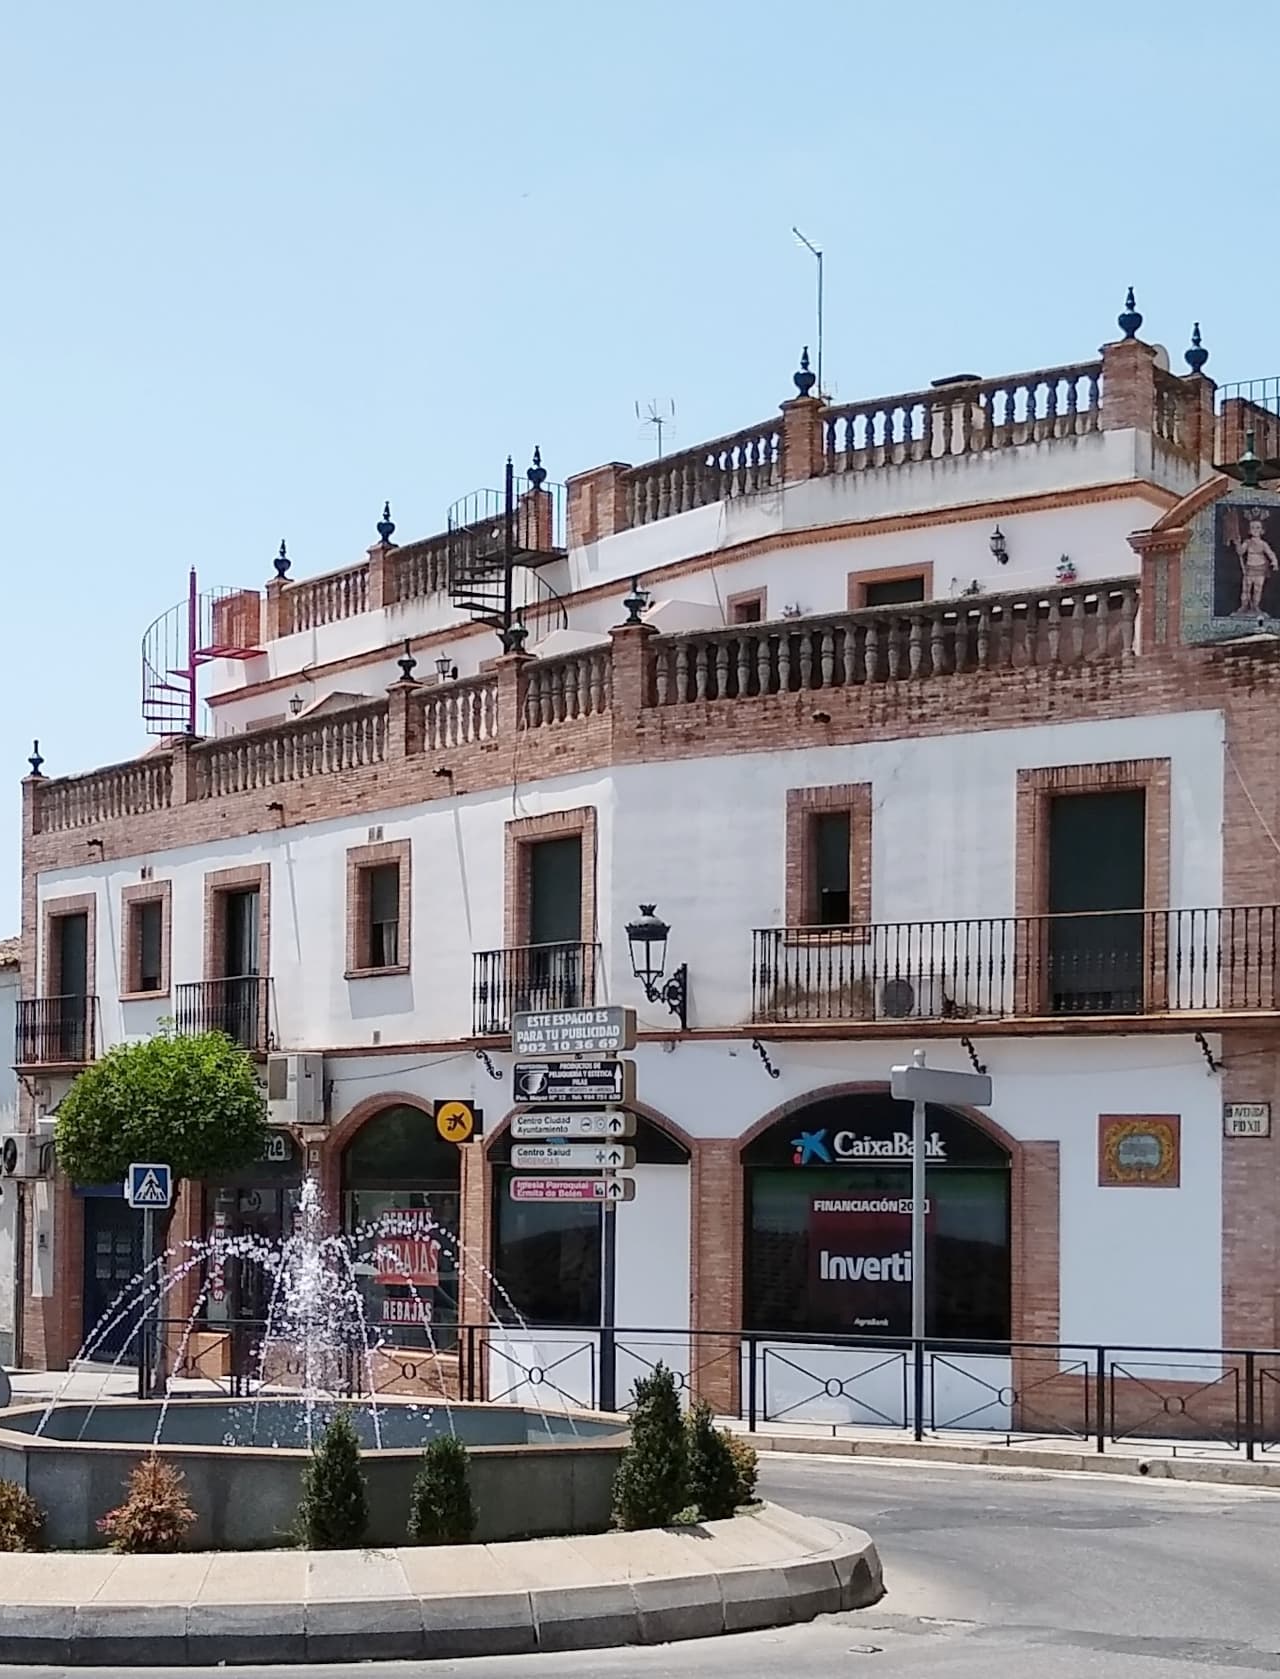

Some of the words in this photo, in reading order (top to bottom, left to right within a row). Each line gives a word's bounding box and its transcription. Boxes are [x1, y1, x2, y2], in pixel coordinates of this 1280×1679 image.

[527, 1015, 551, 1028] ESTE
[552, 1012, 593, 1026] ESPACIO
[596, 1011, 608, 1023] ES
[517, 1030, 544, 1042] PARA
[545, 1029, 559, 1041] TU
[561, 1025, 620, 1040] PUBLICIDAD
[519, 1042, 546, 1053] 902
[552, 1041, 570, 1051] 10
[575, 1039, 593, 1050] 36
[598, 1038, 618, 1049] 69
[517, 1116, 543, 1125] Centro
[544, 1116, 571, 1125] Ciudad
[517, 1125, 569, 1136] Ayuntamiento
[517, 1148, 545, 1157] Centro
[546, 1148, 571, 1157] Salud
[517, 1181, 545, 1190] Iglesia
[546, 1181, 589, 1190] Parroquial
[813, 1198, 898, 1212] FINANCIACIÓN
[900, 1200, 928, 1212] 200
[377, 1242, 439, 1275] REBAJAS
[383, 1300, 433, 1322] REBAJAS
